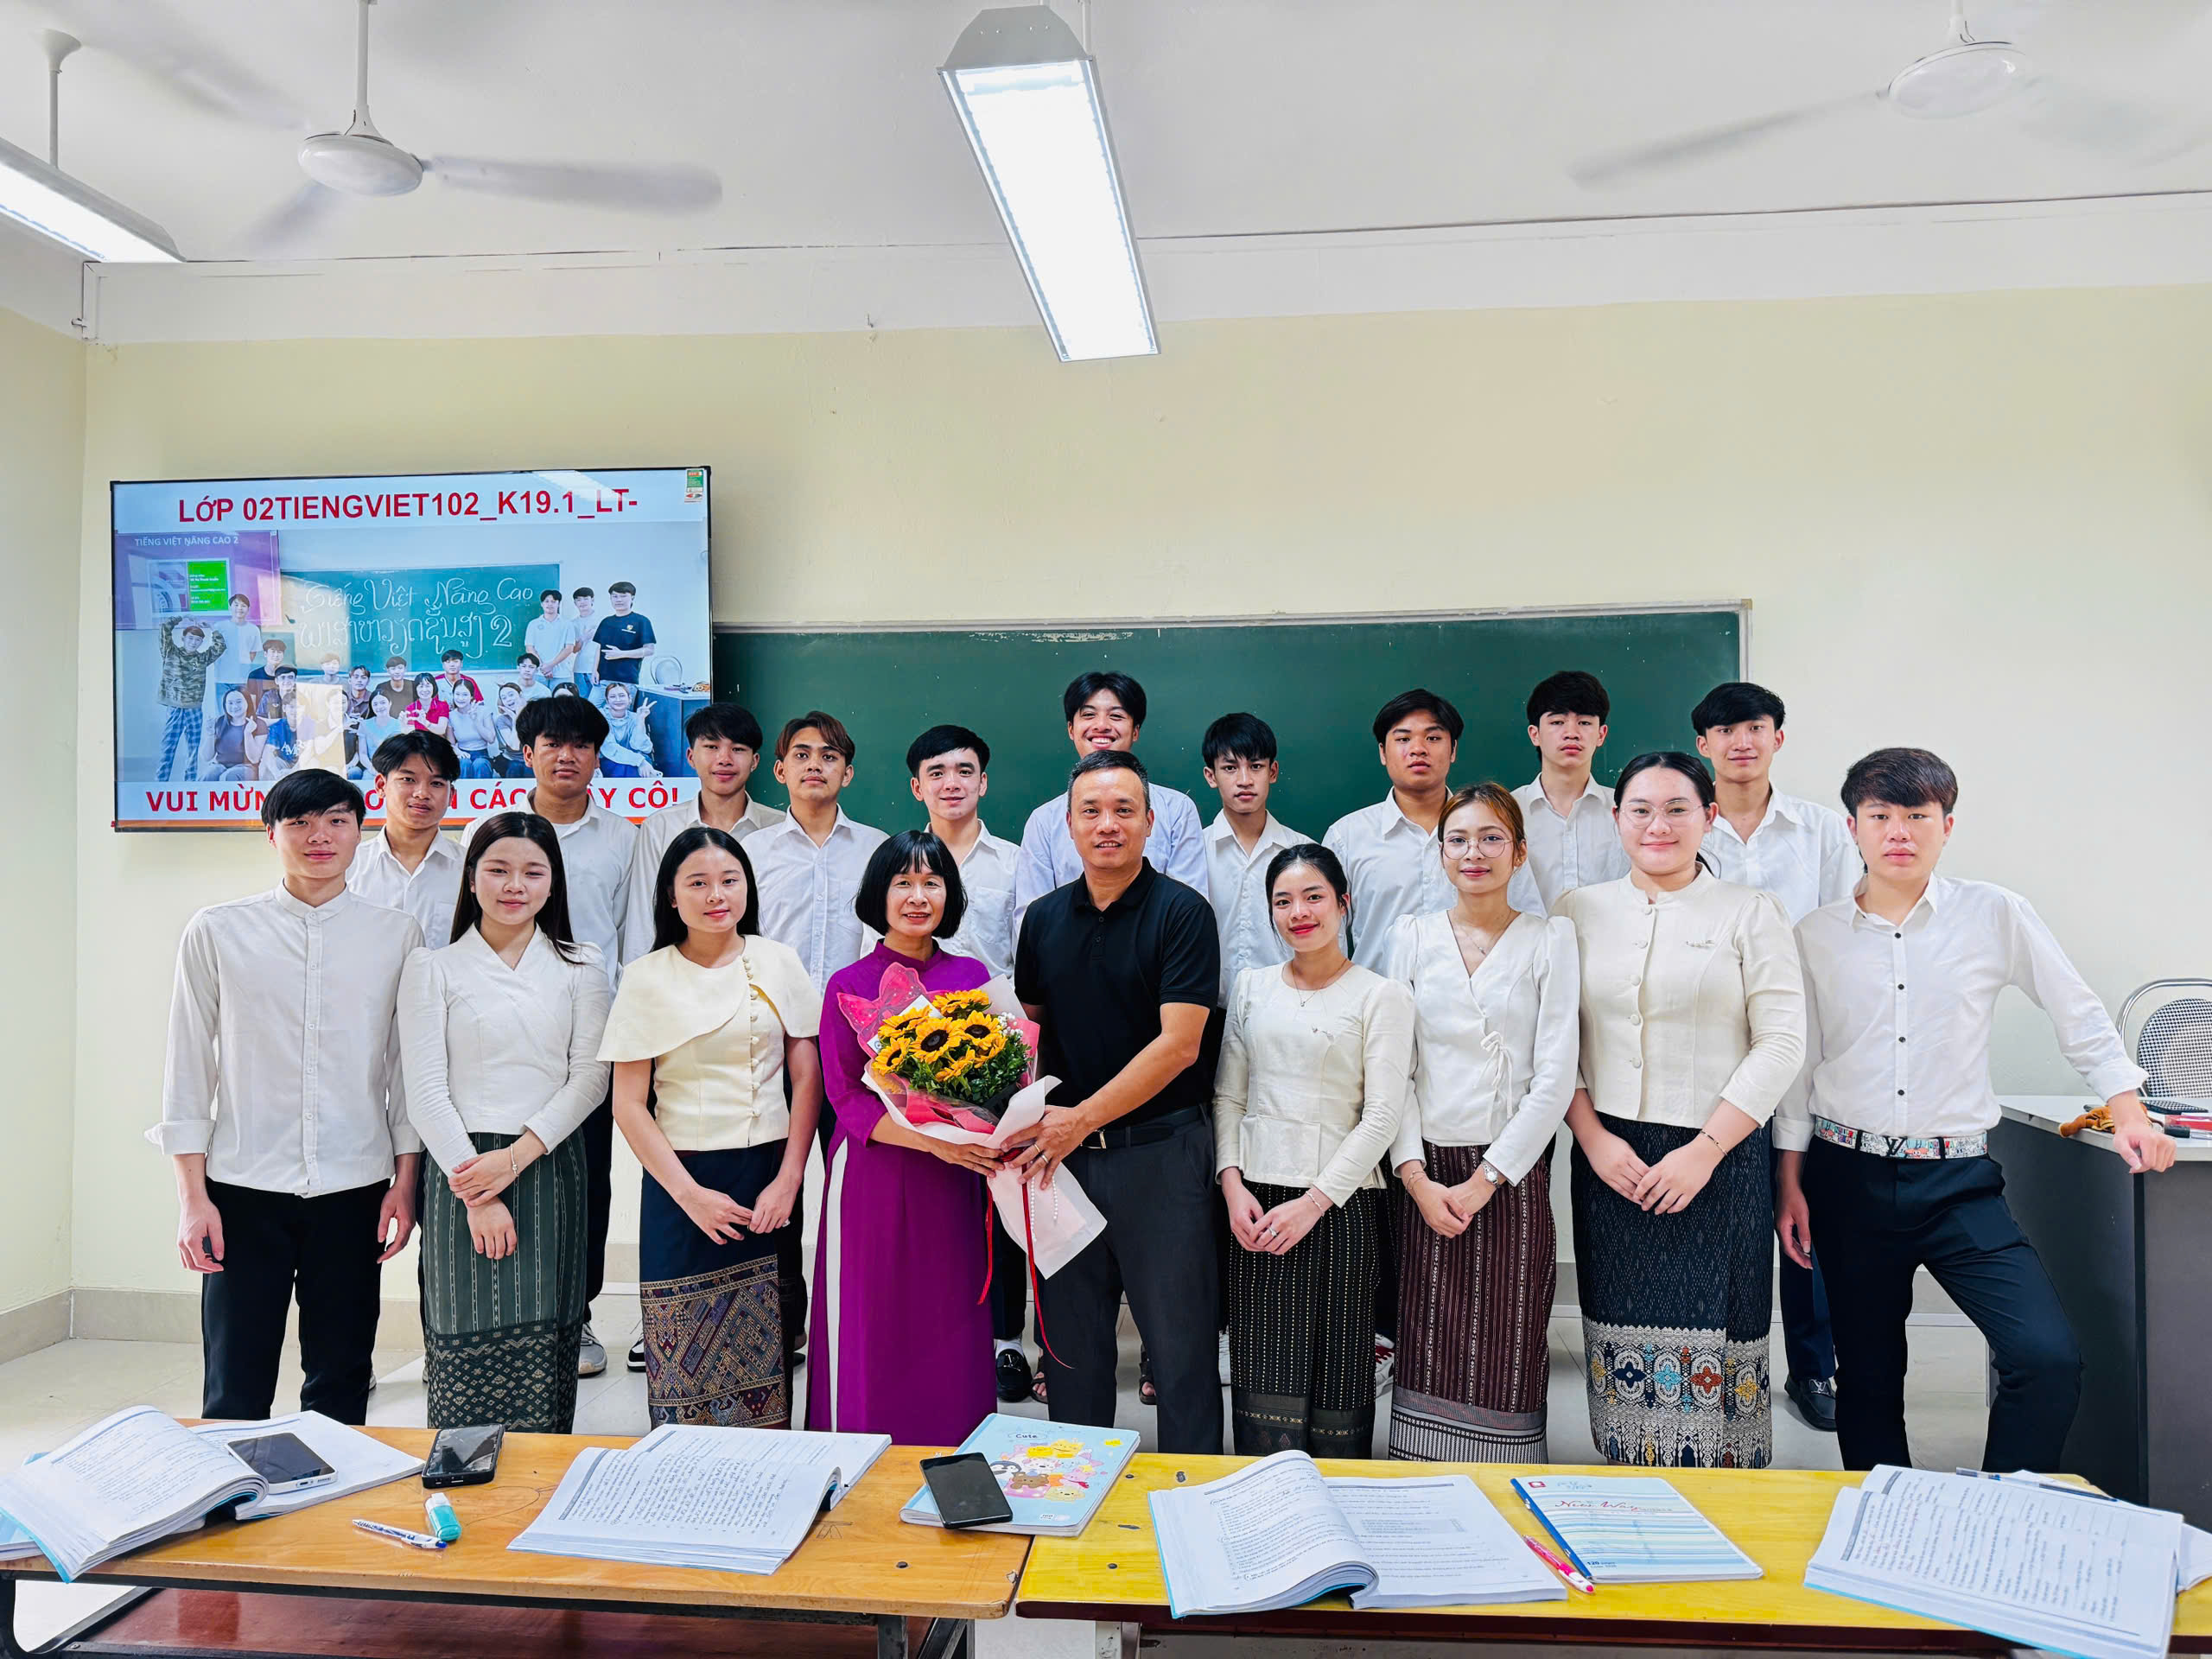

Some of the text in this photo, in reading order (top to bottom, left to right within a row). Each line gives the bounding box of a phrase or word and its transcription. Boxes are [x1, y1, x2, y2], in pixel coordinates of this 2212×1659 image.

[179, 495, 233, 522] LỚP
[135, 536, 161, 546] TIẾNG
[213, 536, 231, 544] CAO
[233, 536, 238, 544] 2
[497, 577, 533, 601] Cao
[490, 614, 512, 647] 2
[146, 791, 198, 812] VUI
[628, 780, 678, 810] CÔ!
